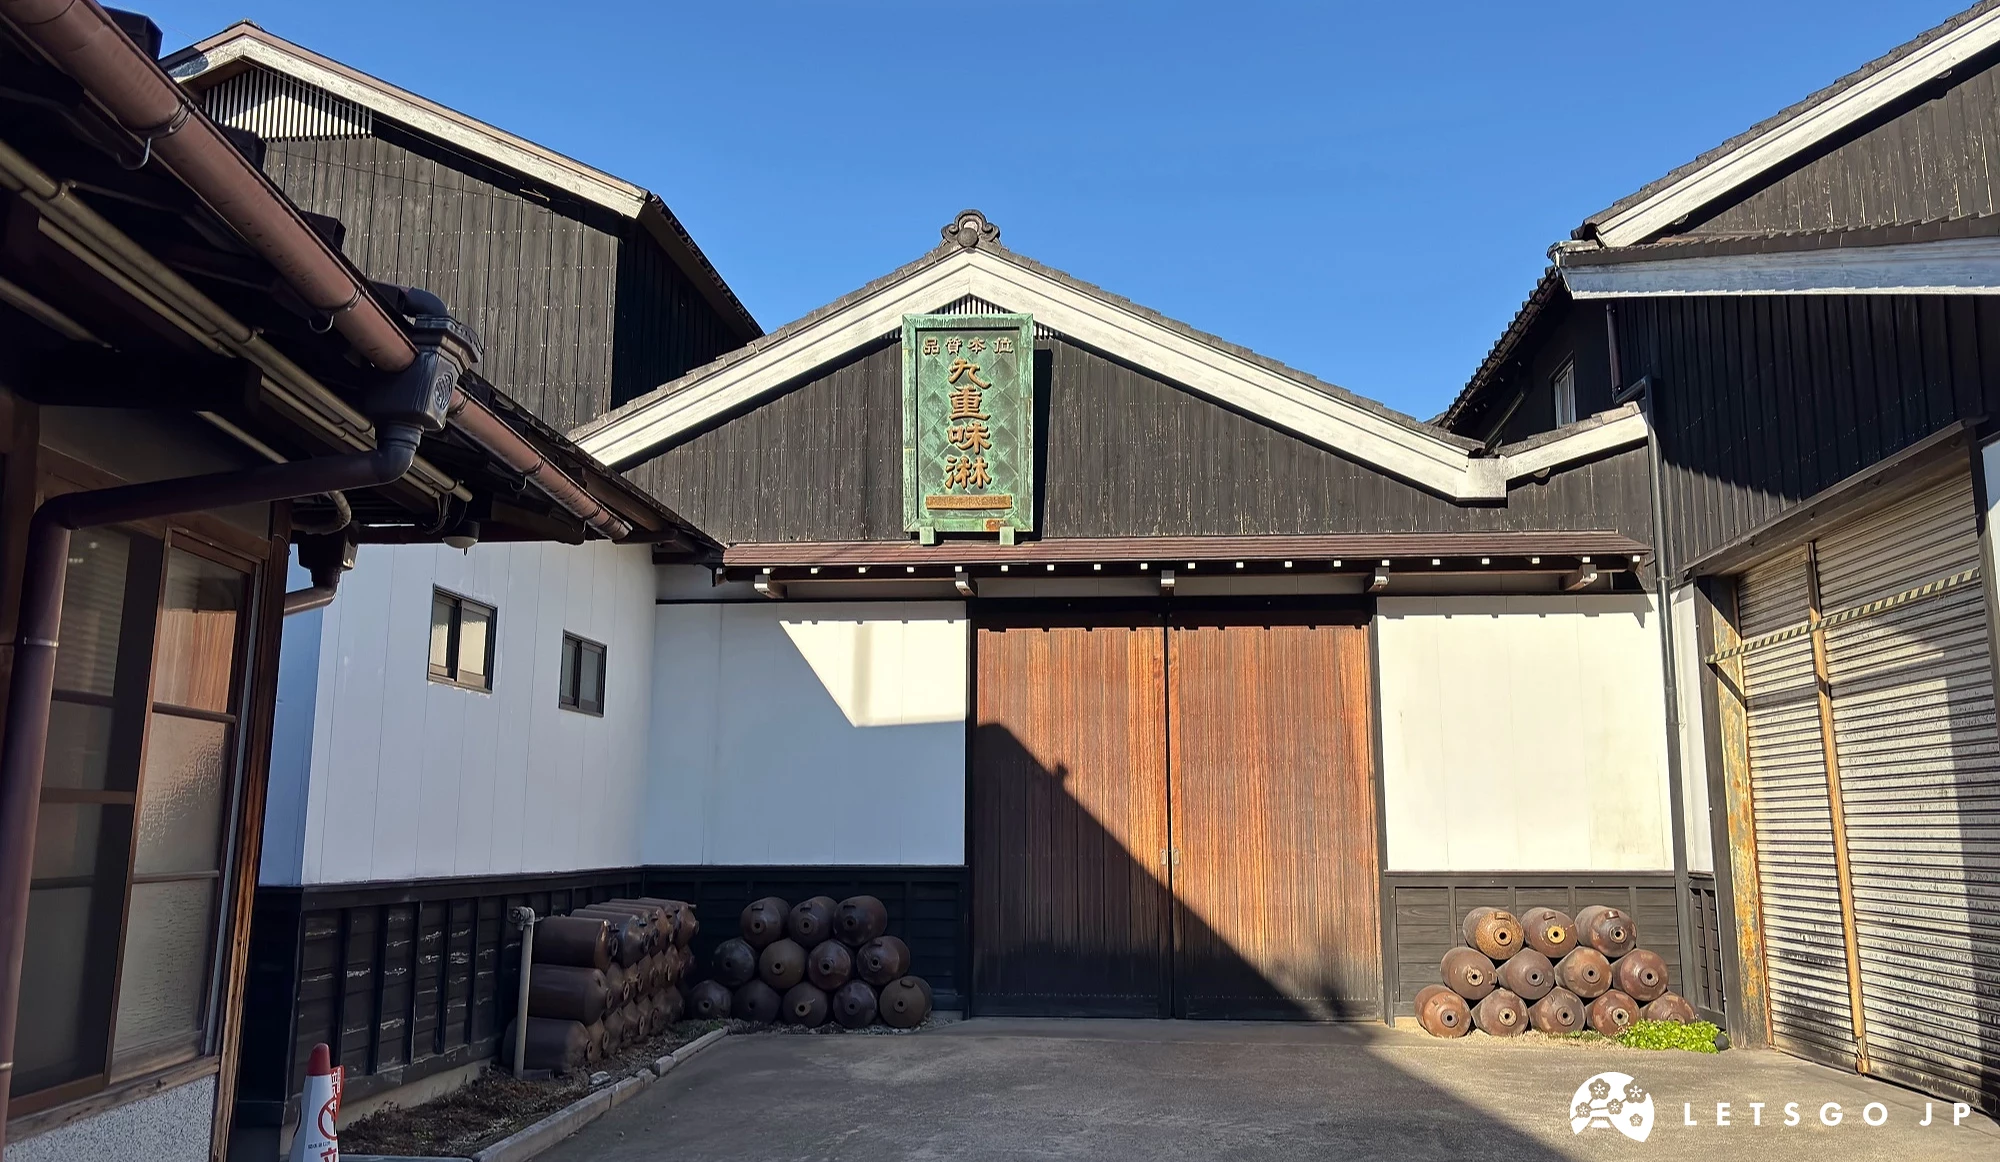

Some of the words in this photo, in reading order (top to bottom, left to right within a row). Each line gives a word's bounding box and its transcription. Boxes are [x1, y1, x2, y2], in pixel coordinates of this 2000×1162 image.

[923, 336, 1013, 355] 品質本位
[945, 357, 992, 490] 九重味淋
